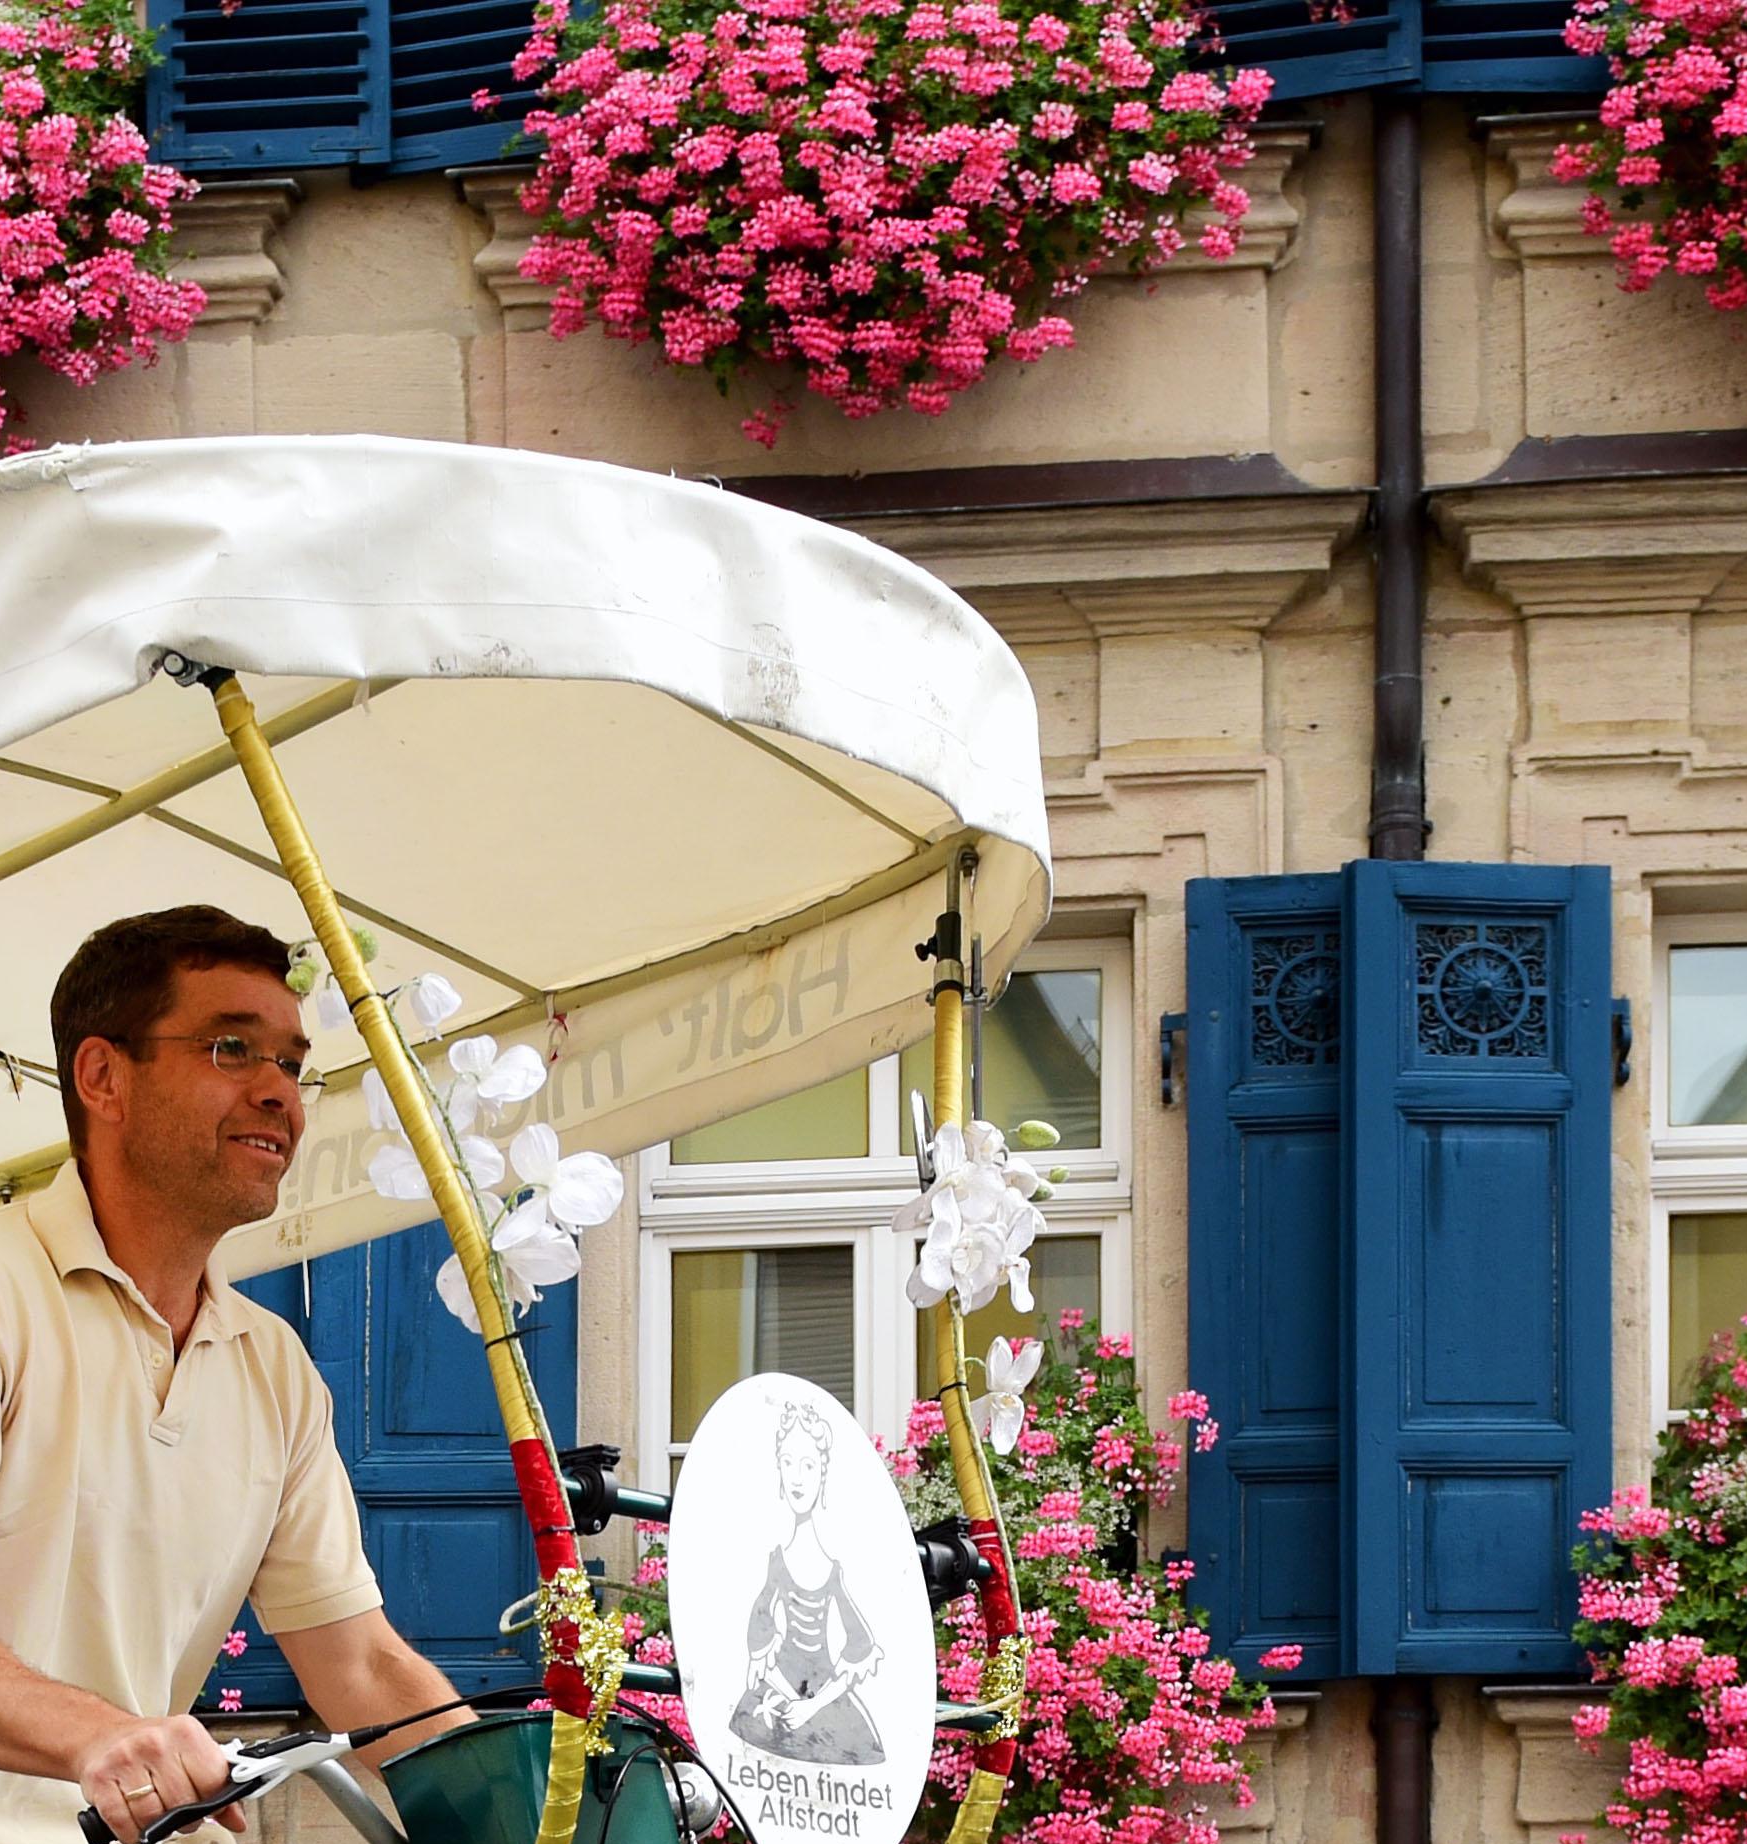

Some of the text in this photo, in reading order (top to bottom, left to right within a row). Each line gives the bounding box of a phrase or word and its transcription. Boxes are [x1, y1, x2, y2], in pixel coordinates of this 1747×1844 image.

[727, 1753, 893, 1811] Leben findet
[758, 1794, 861, 1839] Altstadt
